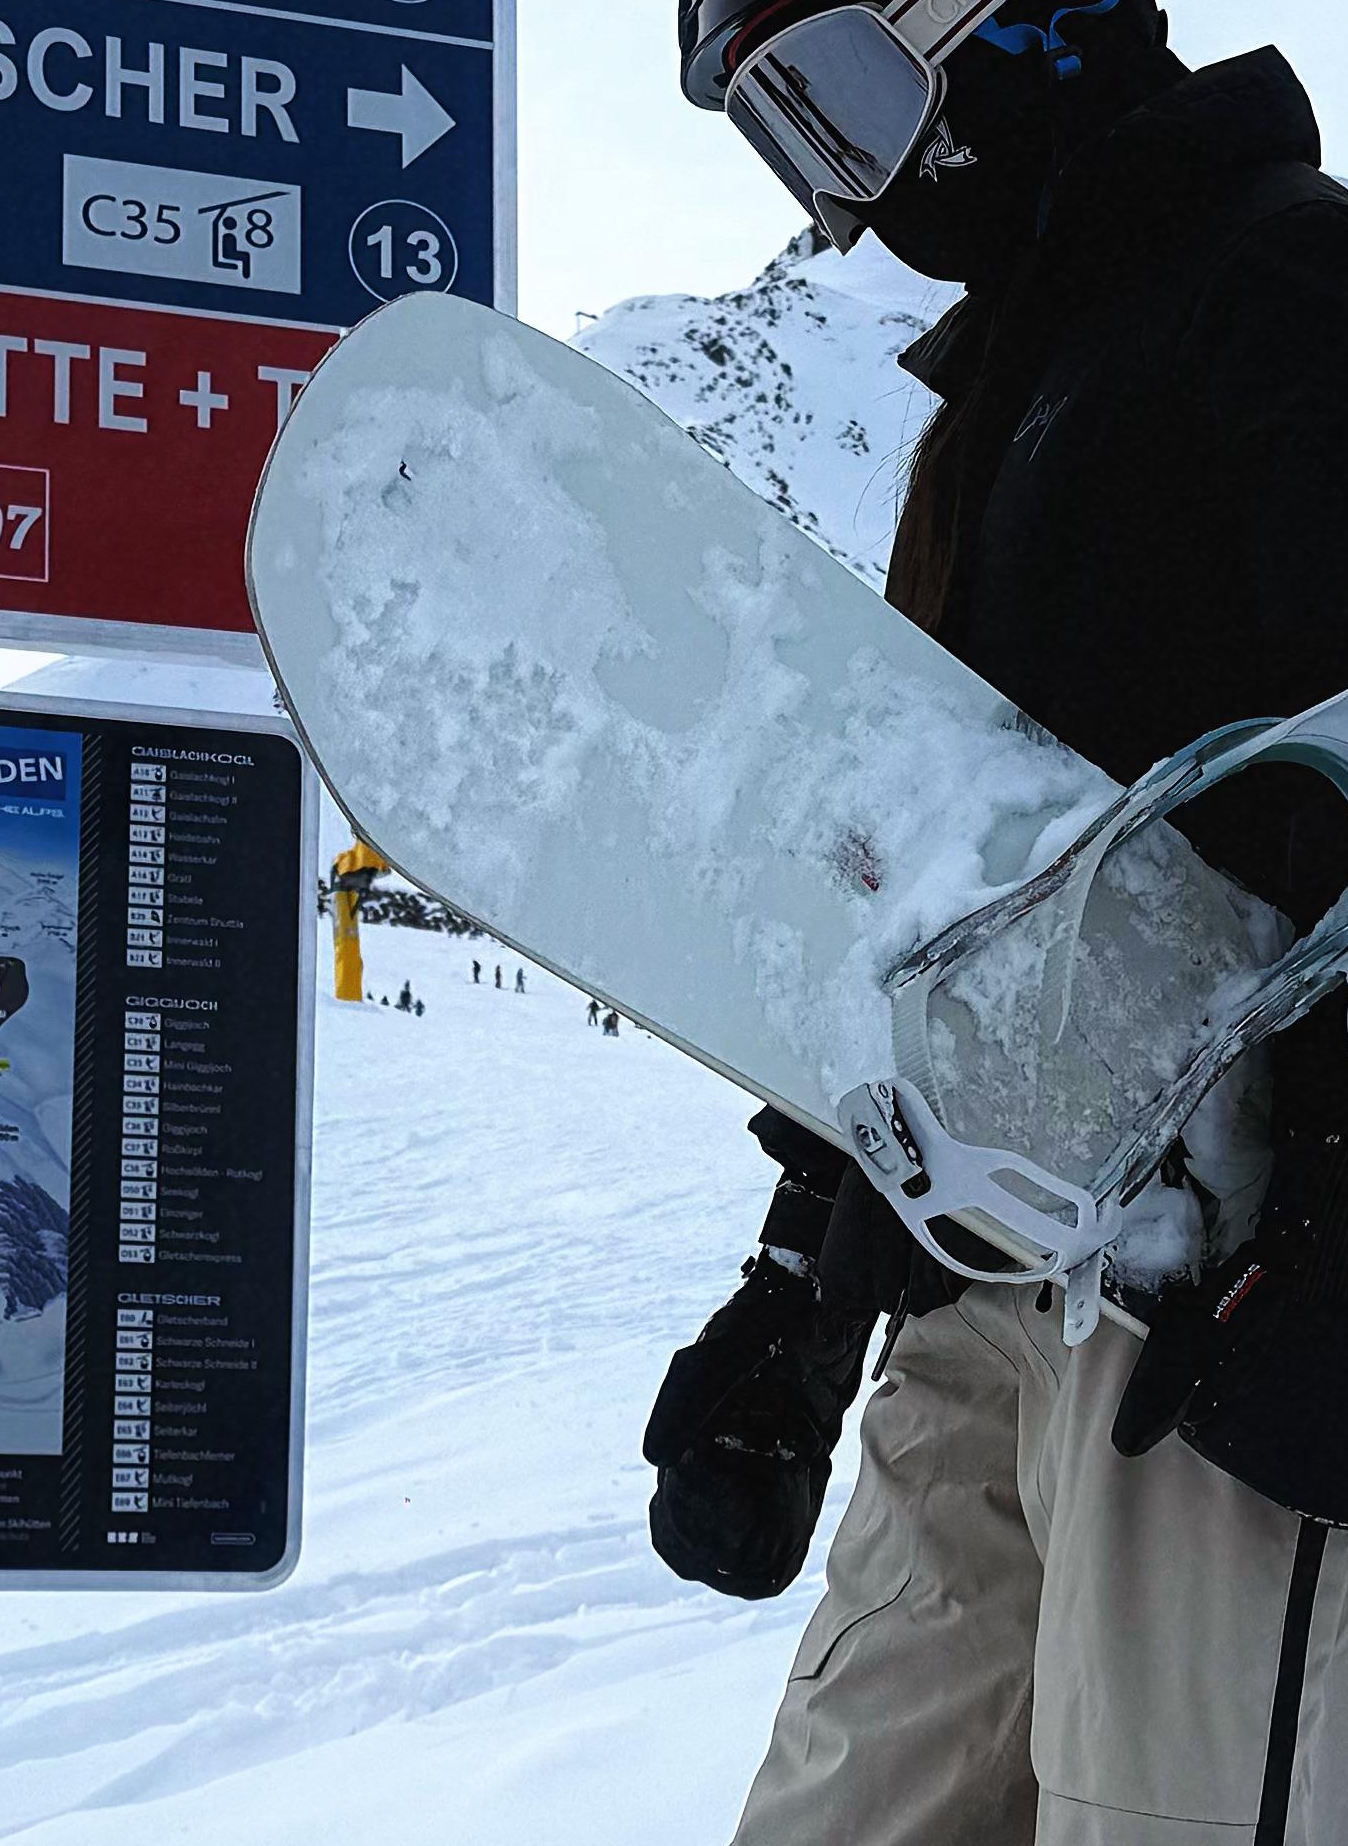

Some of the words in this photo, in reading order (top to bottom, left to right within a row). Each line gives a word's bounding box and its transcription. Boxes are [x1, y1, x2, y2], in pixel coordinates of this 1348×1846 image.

[82, 194, 181, 245] C35
[367, 225, 442, 284] 13
[179, 370, 229, 429] +
[132, 746, 255, 766] GAISLACHKOGL
[125, 995, 218, 1011] GIGGIJOCH
[117, 1292, 221, 1306] GLETSCHER
